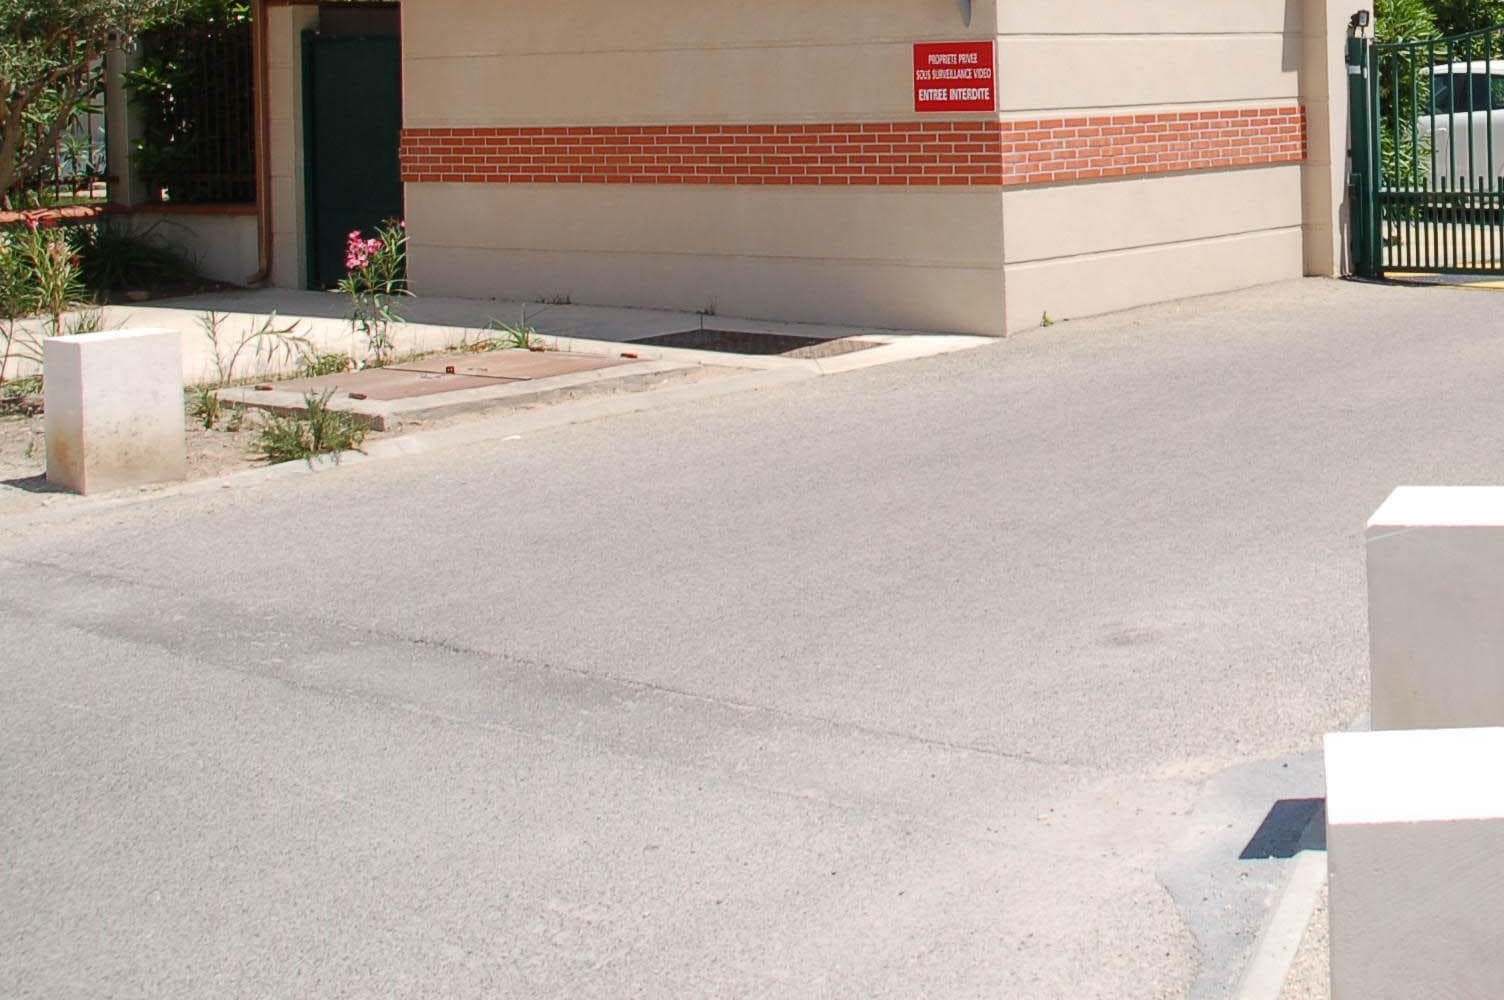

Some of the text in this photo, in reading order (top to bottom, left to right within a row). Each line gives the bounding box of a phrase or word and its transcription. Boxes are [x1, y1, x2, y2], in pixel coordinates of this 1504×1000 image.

[928, 54, 957, 65] PROPRIETE
[916, 67, 991, 80] SOUS SURVEILLANCE VIDEO
[919, 87, 990, 101] ENTREE INTERDITE
